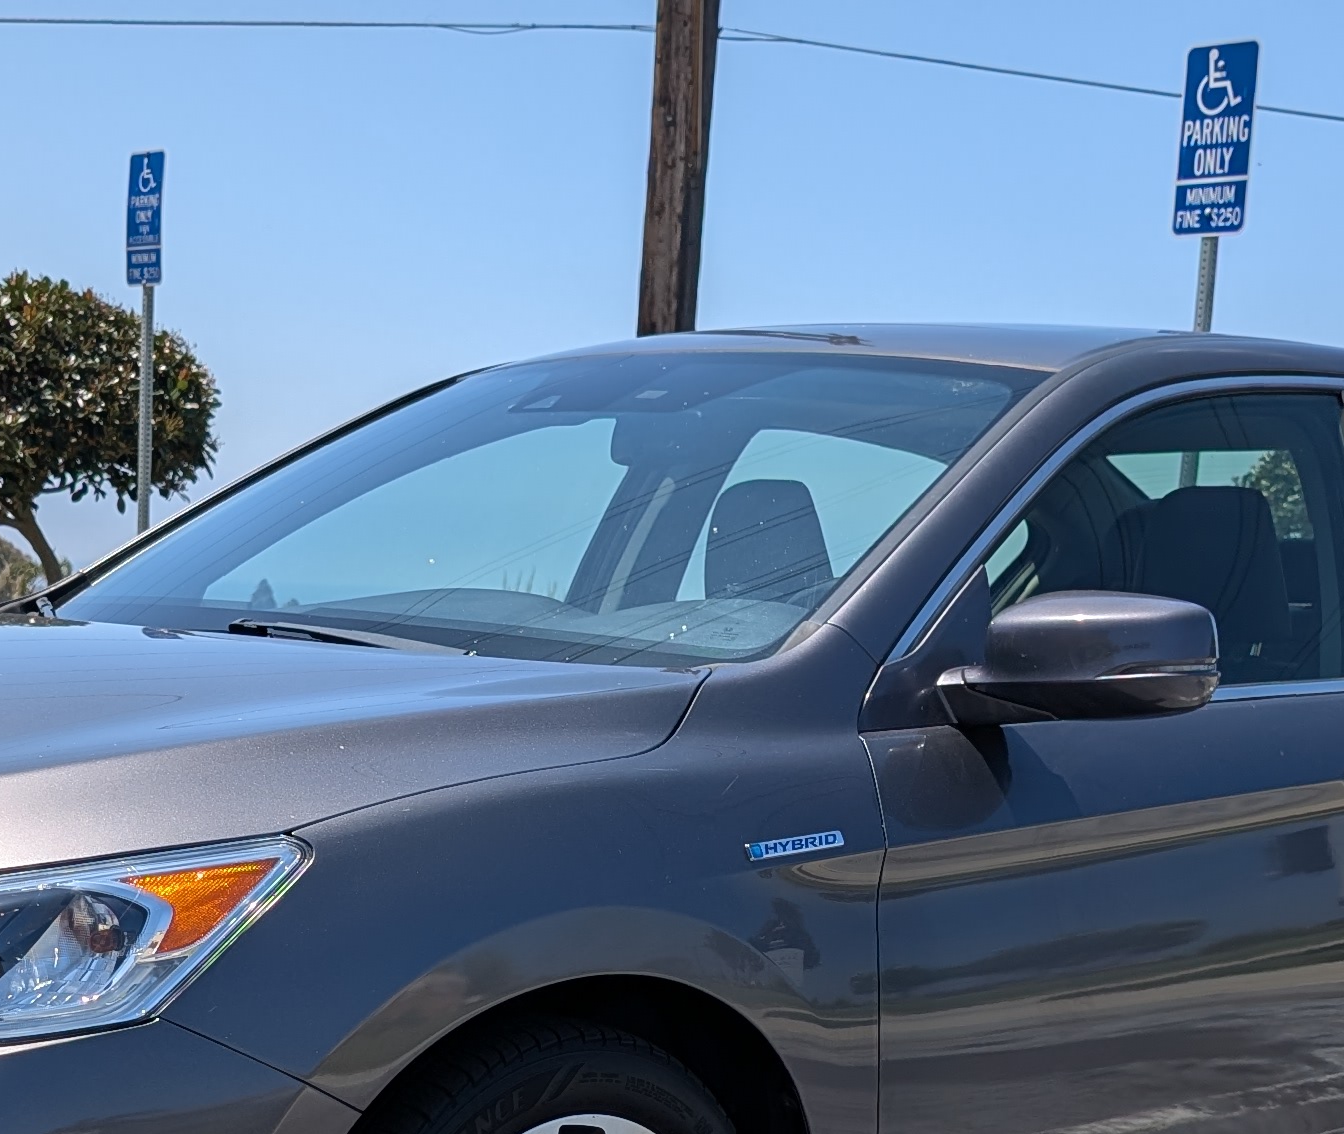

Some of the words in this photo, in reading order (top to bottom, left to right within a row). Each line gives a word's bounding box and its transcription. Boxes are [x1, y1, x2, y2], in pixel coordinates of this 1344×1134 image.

[1183, 115, 1250, 147] PARKING
[1194, 147, 1234, 176] ONLY
[1185, 185, 1236, 206] MINIMUM
[1175, 209, 1201, 229] FINE
[1210, 207, 1241, 228] $250
[765, 833, 837, 855] HYBRID
